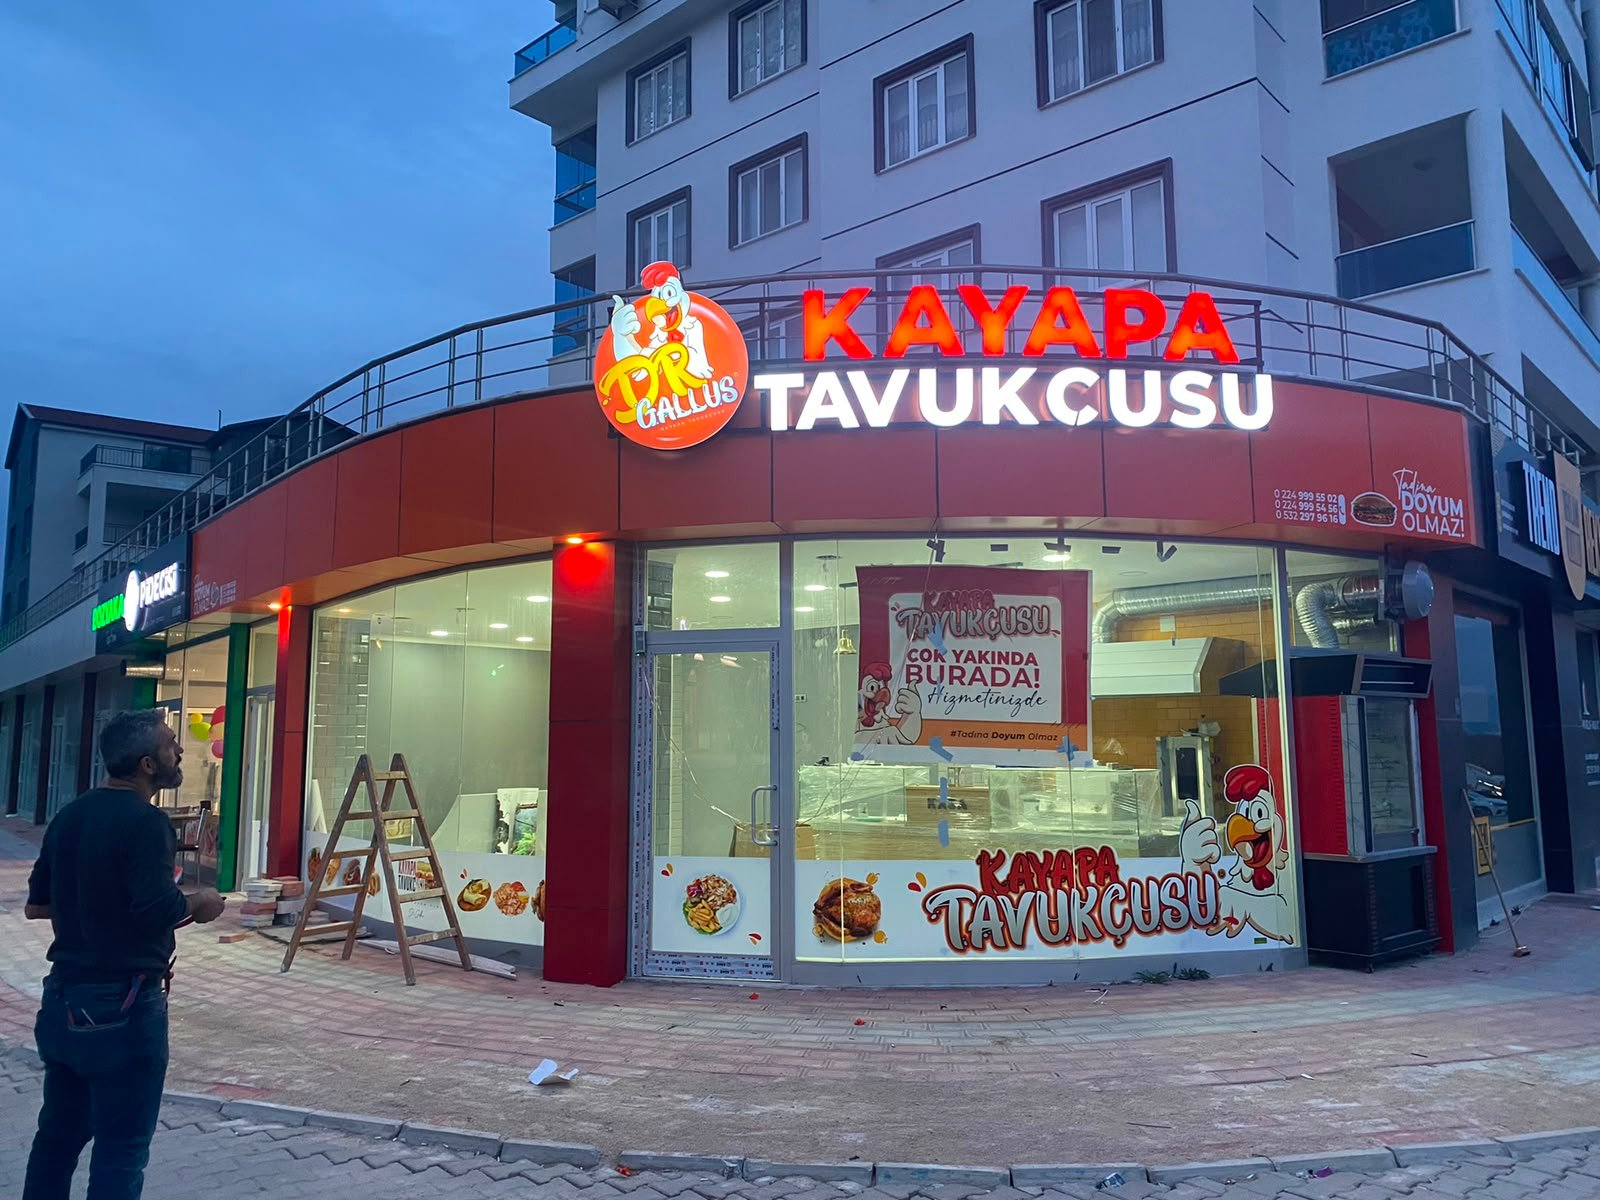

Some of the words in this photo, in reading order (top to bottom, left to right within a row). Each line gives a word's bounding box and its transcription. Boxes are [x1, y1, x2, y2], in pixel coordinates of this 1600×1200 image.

[803, 284, 1240, 364] KAYAPA
[598, 342, 707, 424] DR
[635, 376, 738, 429] GALLUS
[1273, 488, 1280, 498] 0
[1281, 490, 1297, 499] 224
[1298, 491, 1314, 501] 999
[1315, 493, 1326, 502] 55
[1327, 493, 1338, 503] 02
[1274, 499, 1281, 509] 0
[1282, 500, 1297, 510] 224
[1298, 501, 1315, 511] 999
[1316, 503, 1326, 512] 54
[1327, 504, 1338, 513] 56
[1401, 490, 1464, 518] DOYUM
[1522, 460, 1560, 556] TREND
[1275, 509, 1282, 519] 0
[1283, 510, 1298, 520] 532
[1299, 512, 1315, 521] 297
[1316, 513, 1328, 523] 96
[1329, 514, 1339, 523] 16
[1402, 512, 1465, 538] OLMAZ!
[896, 605, 1050, 640] TAVUKÇUSU
[952, 649, 1039, 666] YAKINDA
[905, 664, 1040, 689] BURADA!
[928, 686, 1047, 717] Hizmetinizde
[991, 731, 1025, 740] Doyum
[1028, 732, 1058, 741] Olmaz
[976, 845, 1120, 896] KAYAPA
[922, 870, 1219, 950] TAVUKÇUSU
